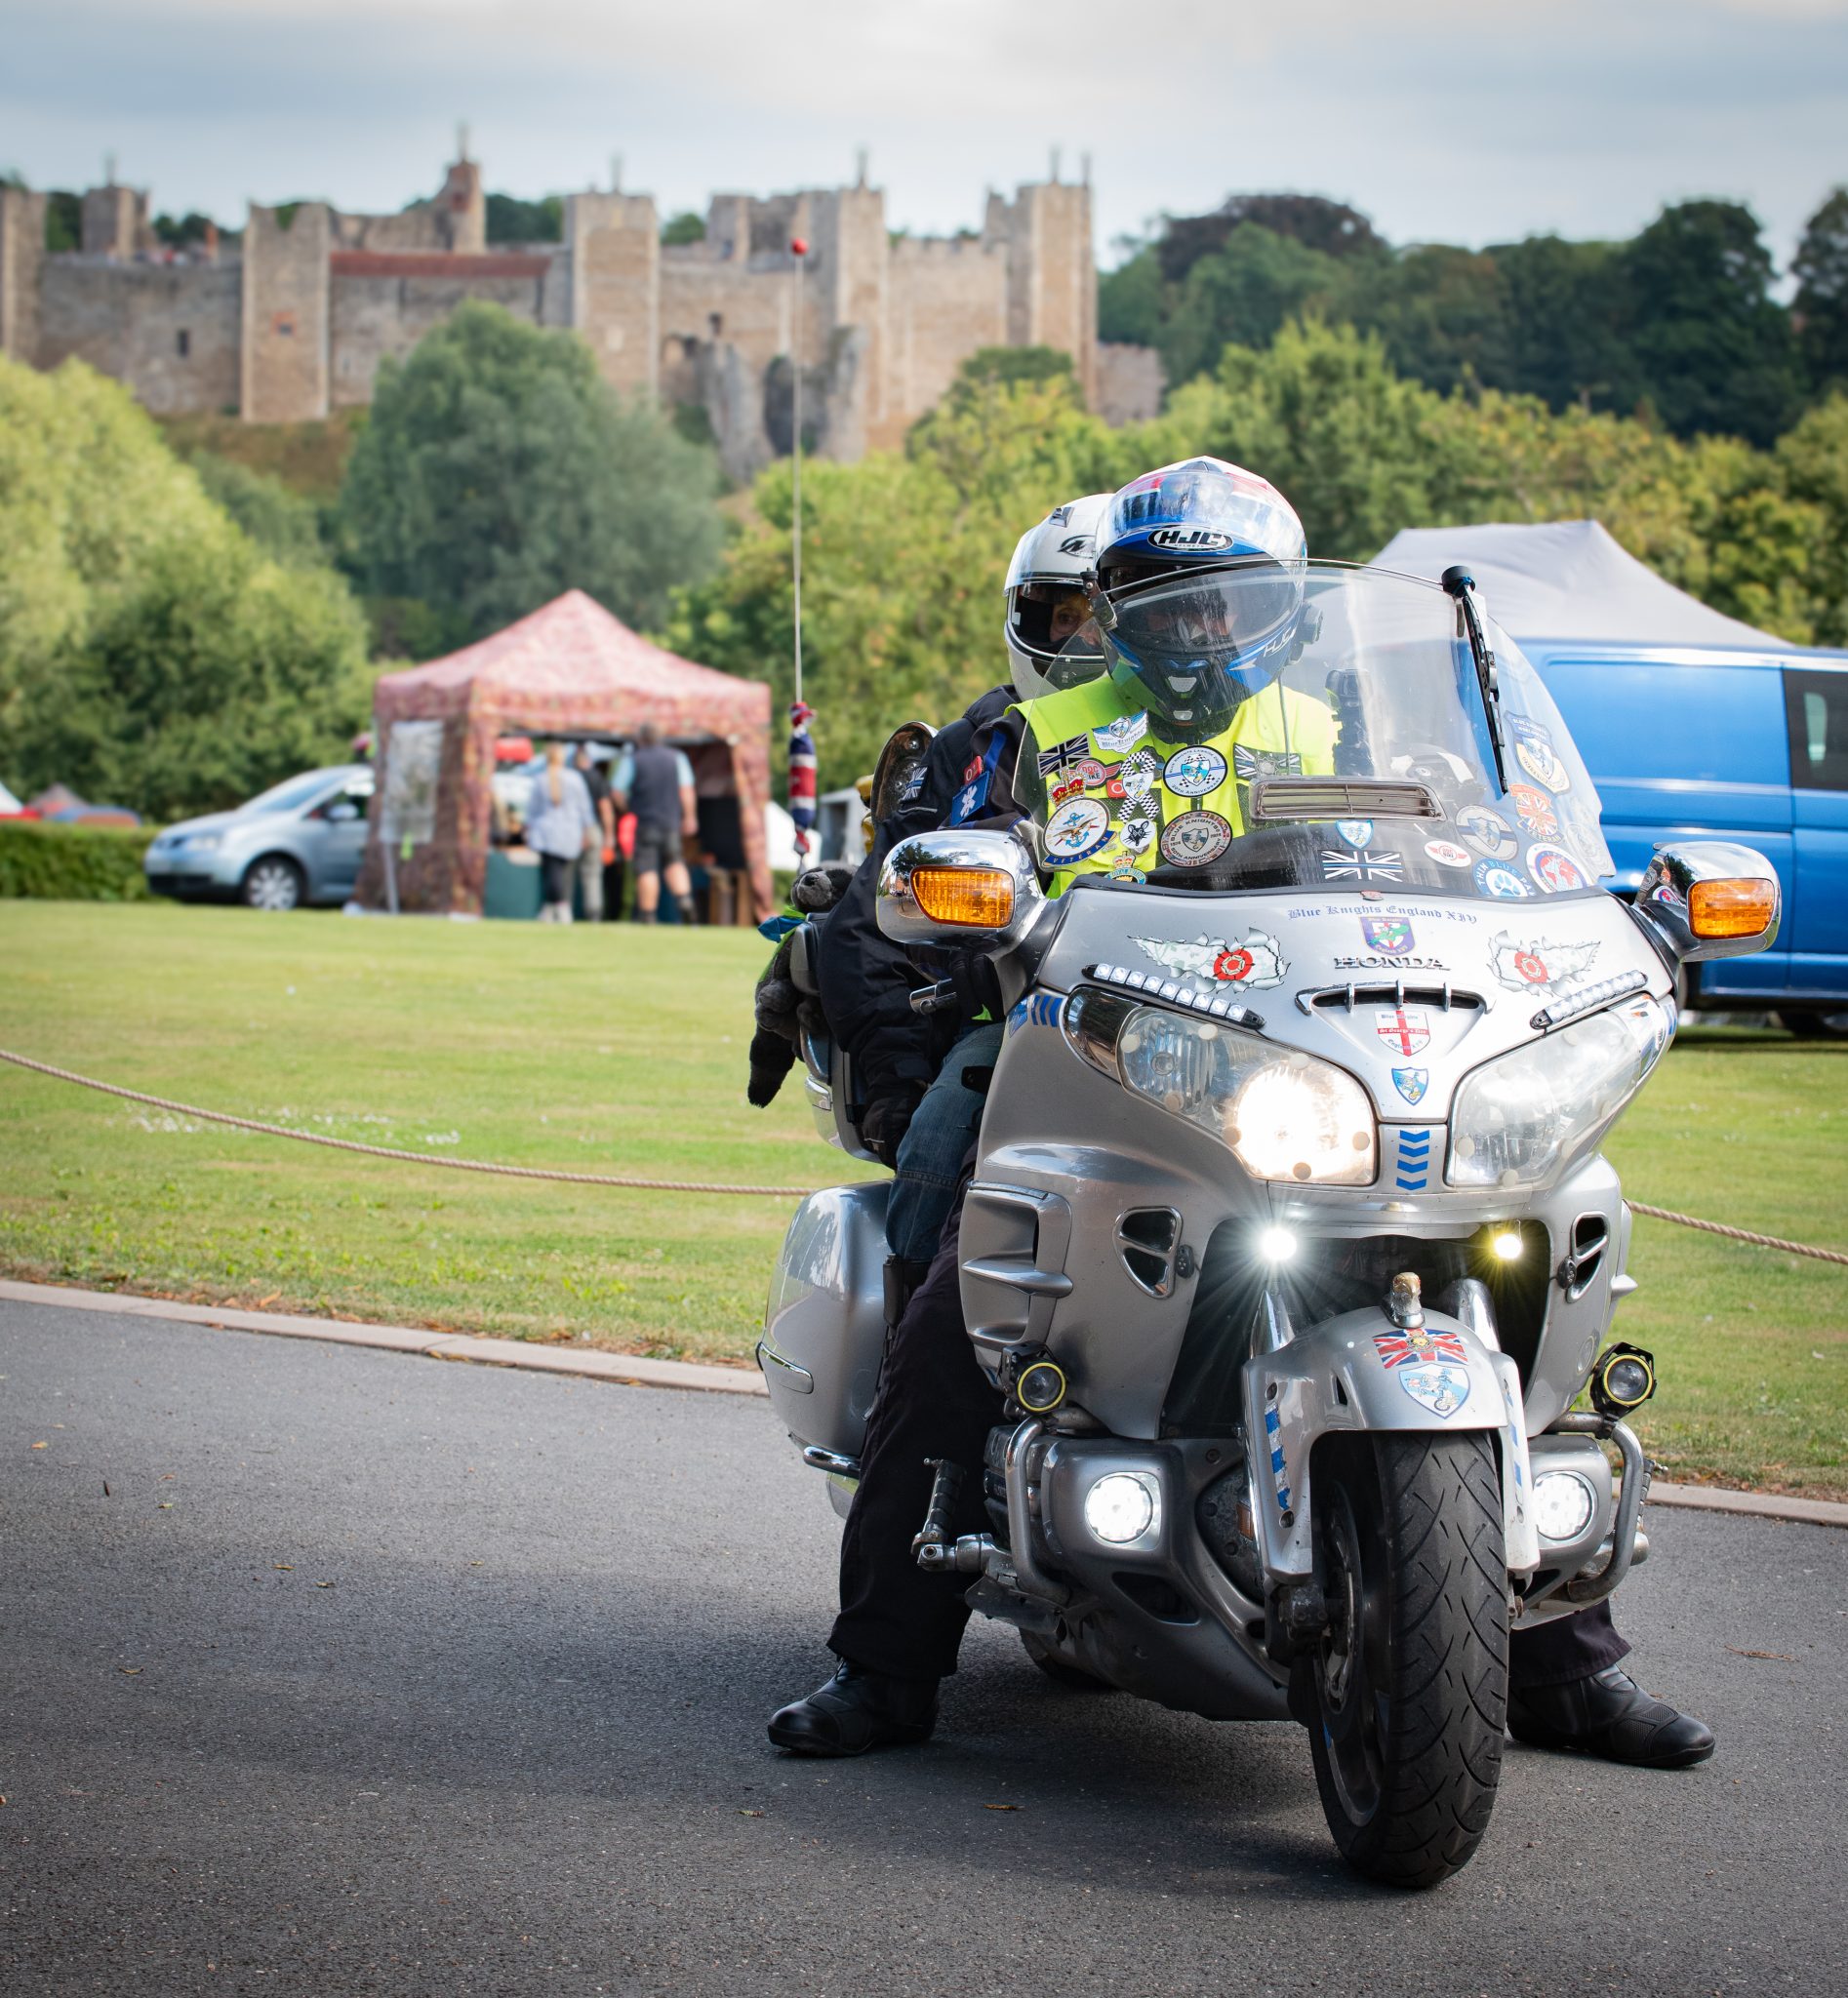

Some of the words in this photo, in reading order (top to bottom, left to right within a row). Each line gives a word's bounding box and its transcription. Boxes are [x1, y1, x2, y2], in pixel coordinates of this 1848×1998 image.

[1158, 531, 1223, 545] HJC
[1170, 824, 1184, 841] BLUE
[1528, 827, 1562, 843] VETERAN
[1053, 836, 1109, 863] VETERAN
[1170, 847, 1183, 858] 50TH
[1183, 838, 1221, 859] ANNIVERSARY
[1476, 862, 1489, 886] THIN
[1487, 860, 1518, 876] BLUE
[1288, 909, 1320, 920] Blue
[1326, 905, 1382, 916] Knights
[1386, 905, 1442, 918] England
[1446, 910, 1477, 924] XIV
[1334, 956, 1451, 971] HONDA
